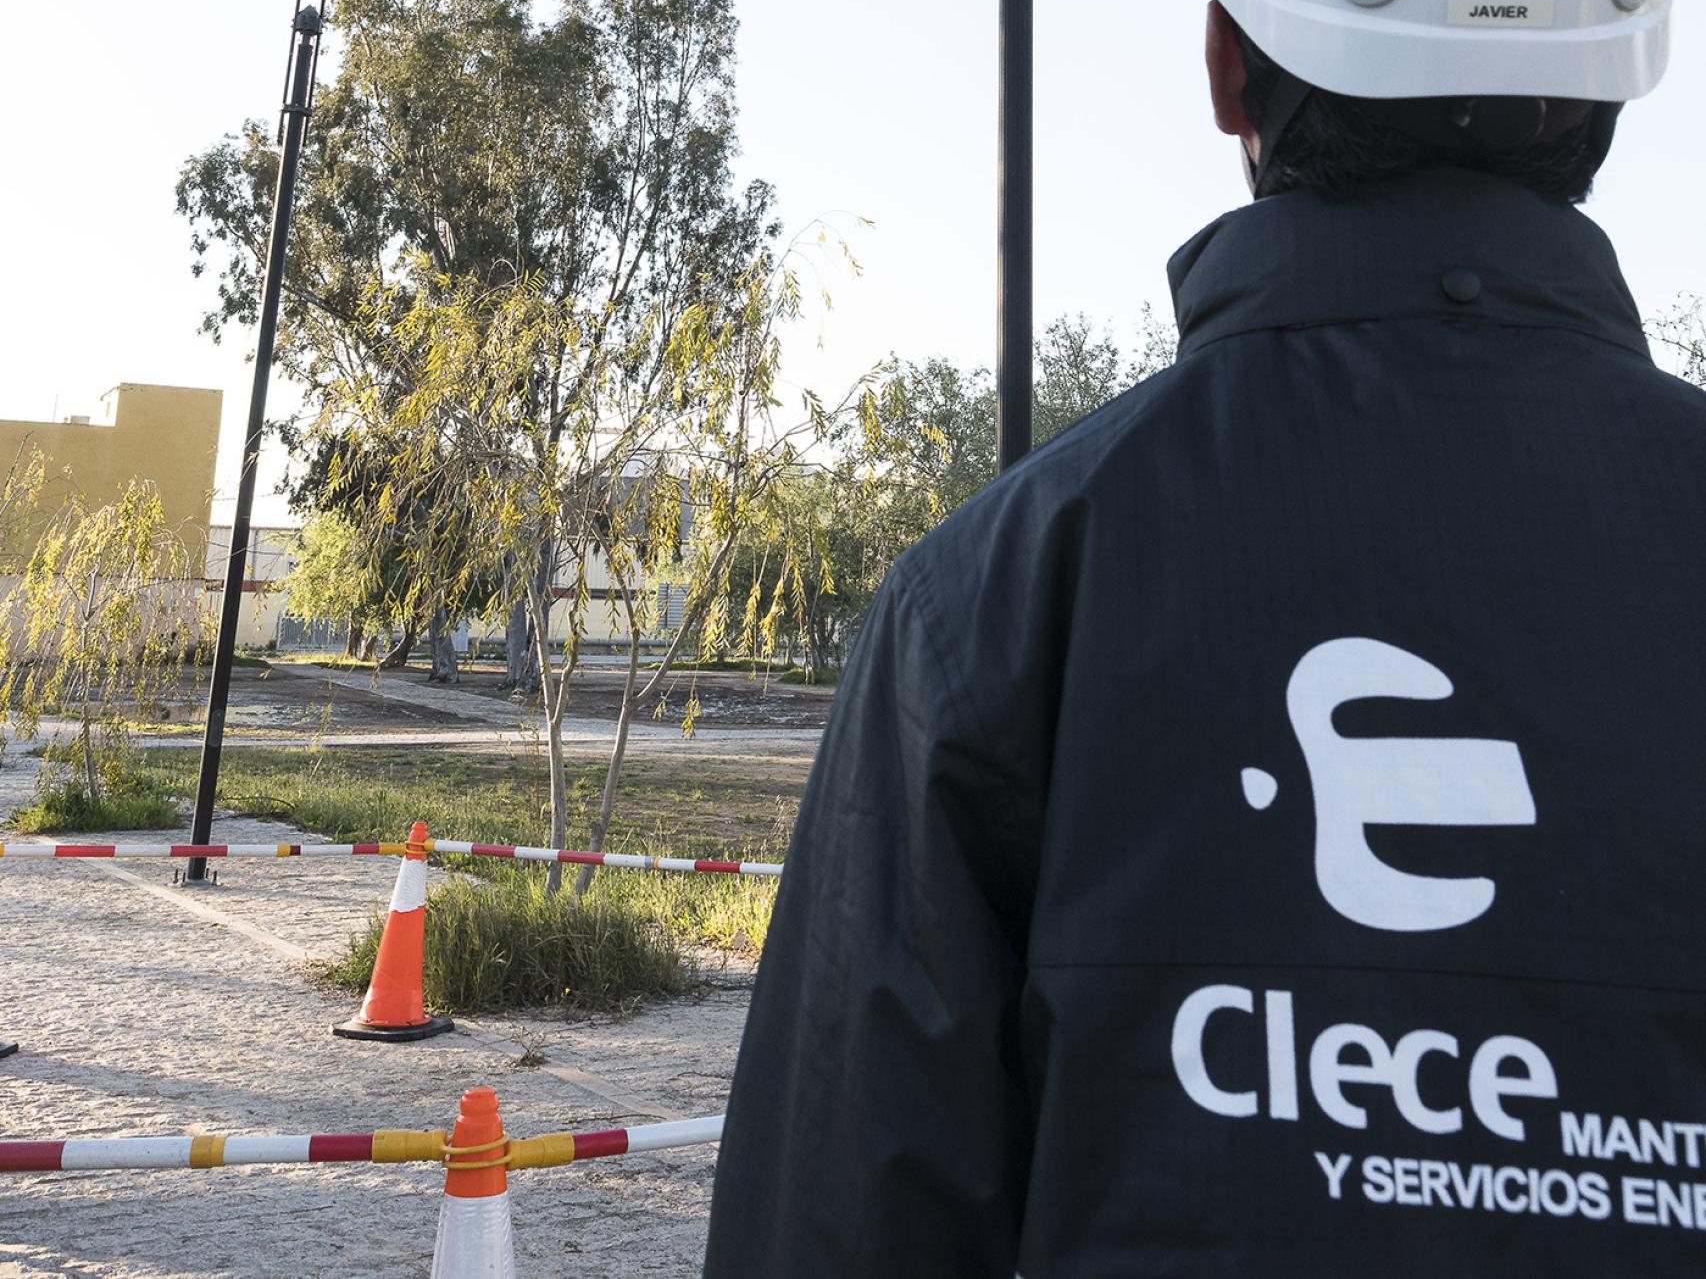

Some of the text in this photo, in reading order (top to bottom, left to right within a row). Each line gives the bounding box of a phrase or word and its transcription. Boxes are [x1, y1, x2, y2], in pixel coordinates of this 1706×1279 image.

[1469, 5, 1529, 19] JAVIER
[1170, 983, 1559, 1142] Clece
[1313, 1150, 1353, 1200] Y
[1361, 1154, 1613, 1220] SERVICIOS
